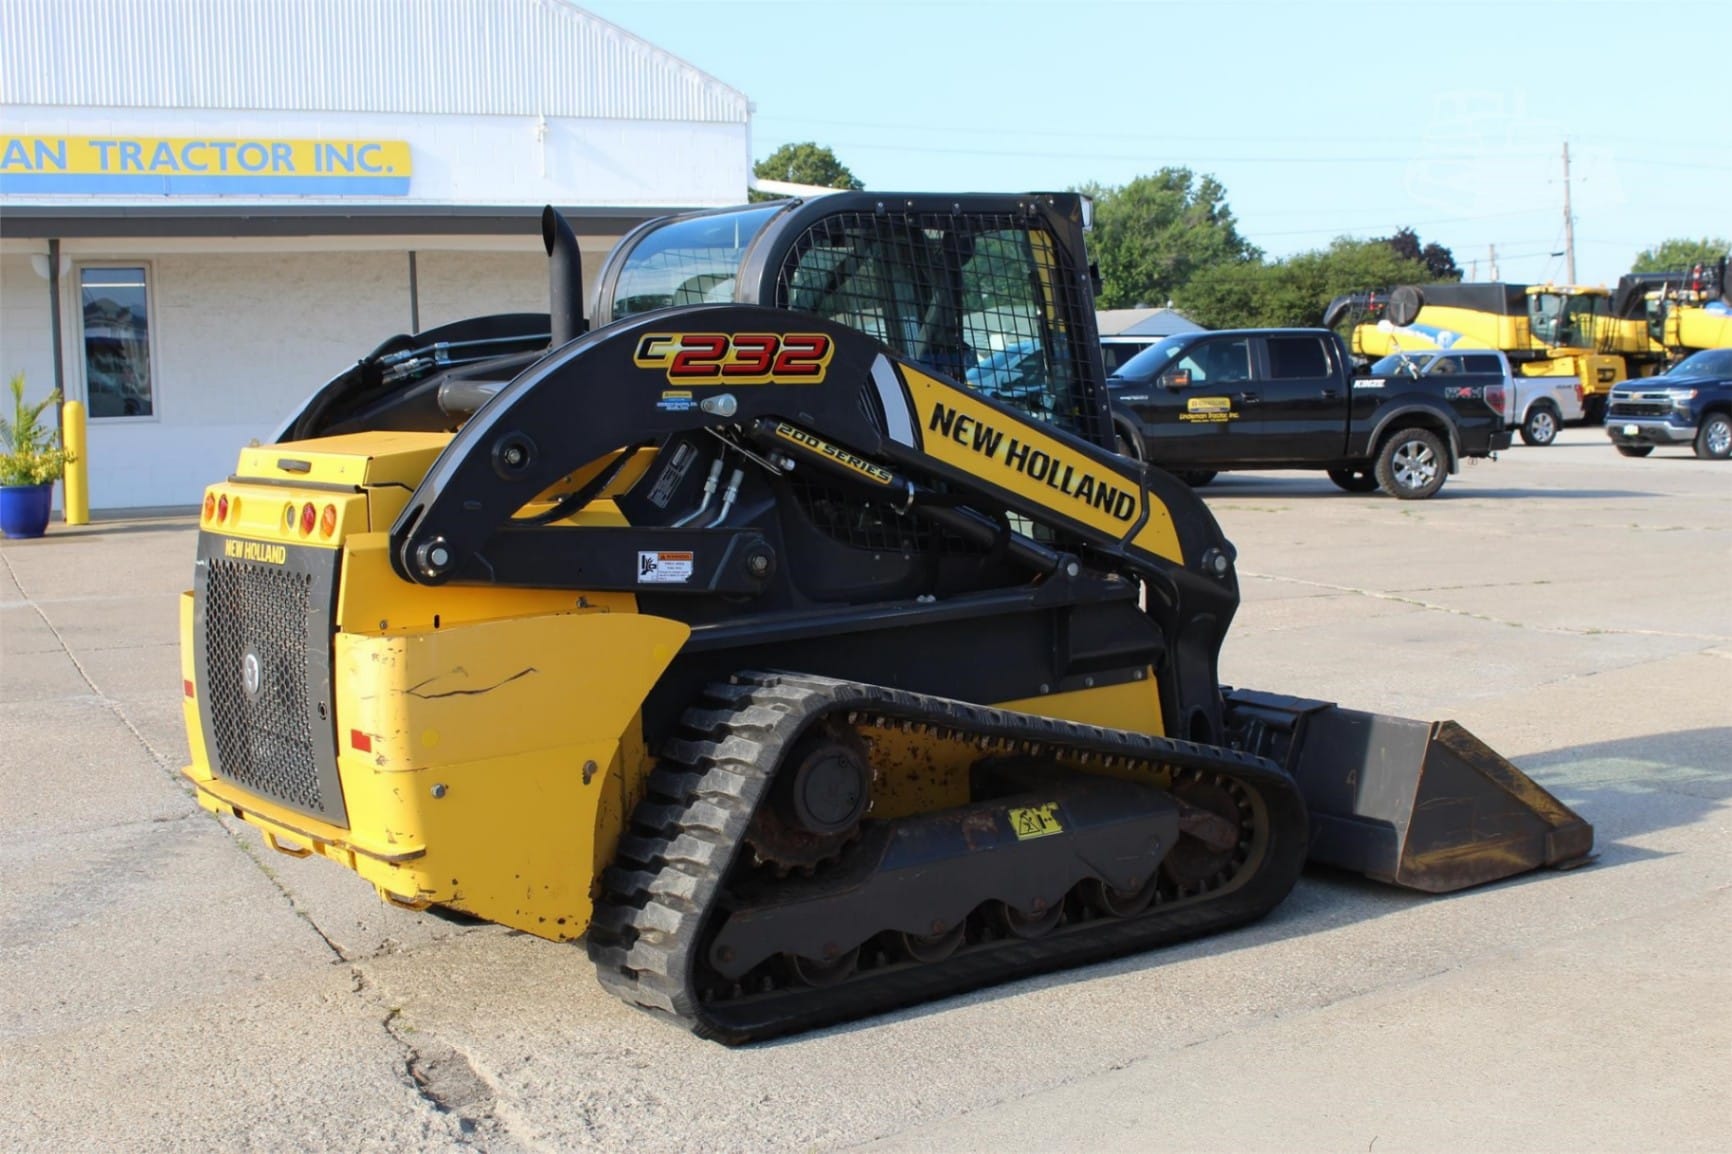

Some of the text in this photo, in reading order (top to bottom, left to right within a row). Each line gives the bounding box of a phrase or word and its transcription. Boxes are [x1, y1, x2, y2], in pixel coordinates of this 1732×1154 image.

[0, 139, 394, 173] AN TRACTOR INC.
[636, 335, 832, 378] C232
[777, 422, 890, 480] 200 SERIES
[929, 402, 1136, 522] NEW HOLLAND
[224, 538, 286, 565] NEW HOLLAND
